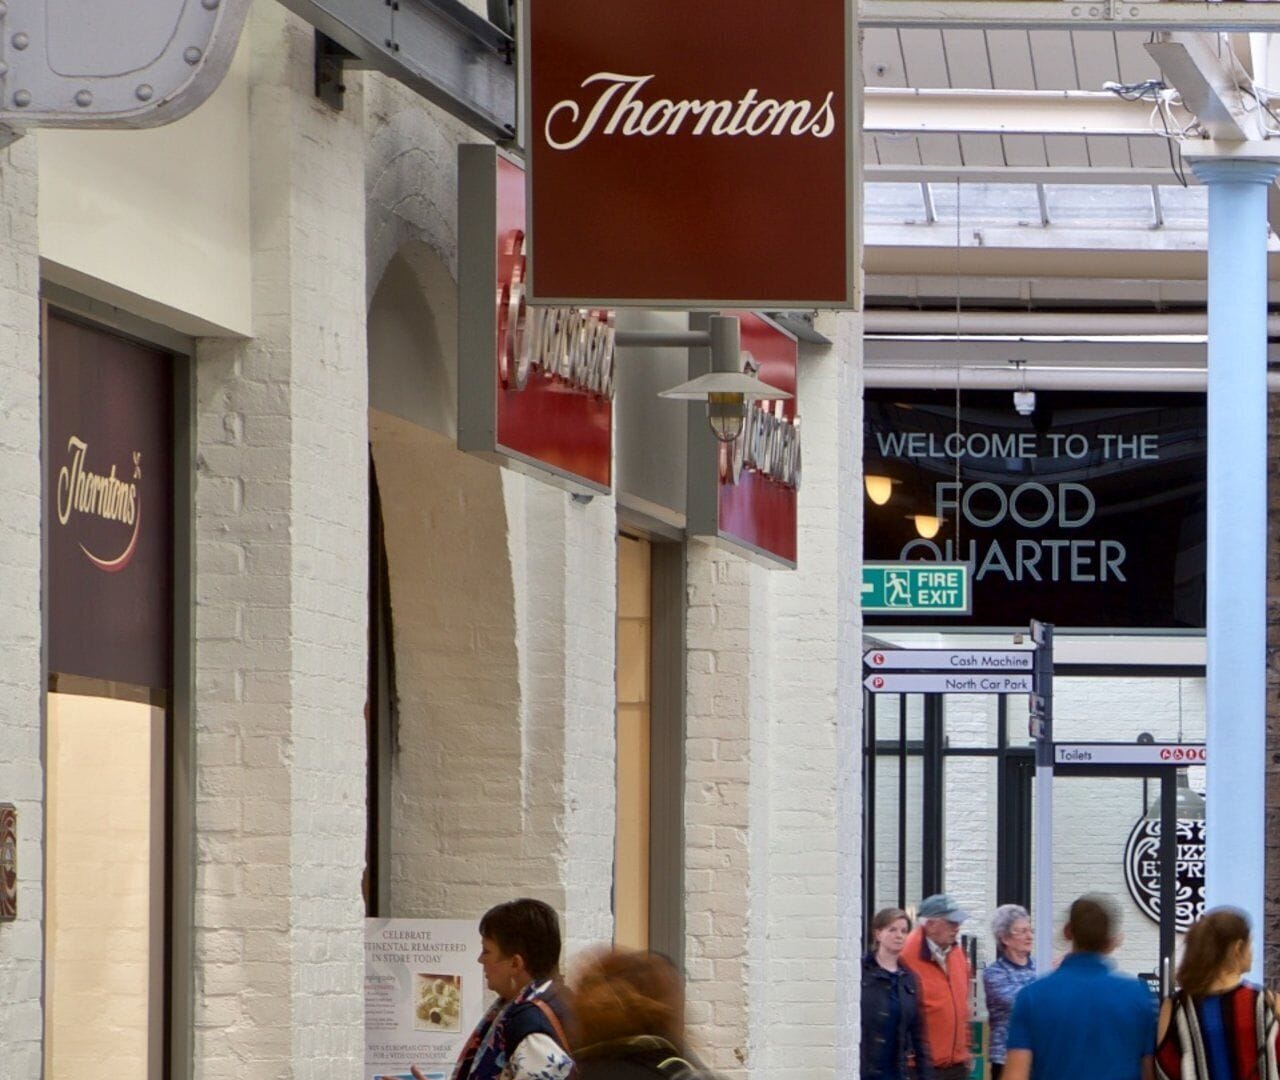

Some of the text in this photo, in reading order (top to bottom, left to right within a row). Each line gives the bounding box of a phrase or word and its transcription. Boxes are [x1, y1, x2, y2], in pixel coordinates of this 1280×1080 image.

[545, 71, 835, 150] Thorntons
[876, 432, 1160, 460] WELCOME TO THE
[57, 435, 137, 525] Thorntons
[936, 481, 1096, 528] FOOD
[918, 572, 959, 588] FIRE
[918, 589, 959, 605] EXIT
[950, 655, 978, 667] Cash
[981, 655, 1029, 667] Machine
[946, 679, 977, 690] North
[980, 680, 1001, 690] Car
[1004, 679, 1028, 690] Park
[1060, 749, 1092, 761] Toilets
[382, 930, 432, 940] CELEBRATE
[411, 943, 467, 952] REMASTERED
[414, 955, 442, 963] TODAY
